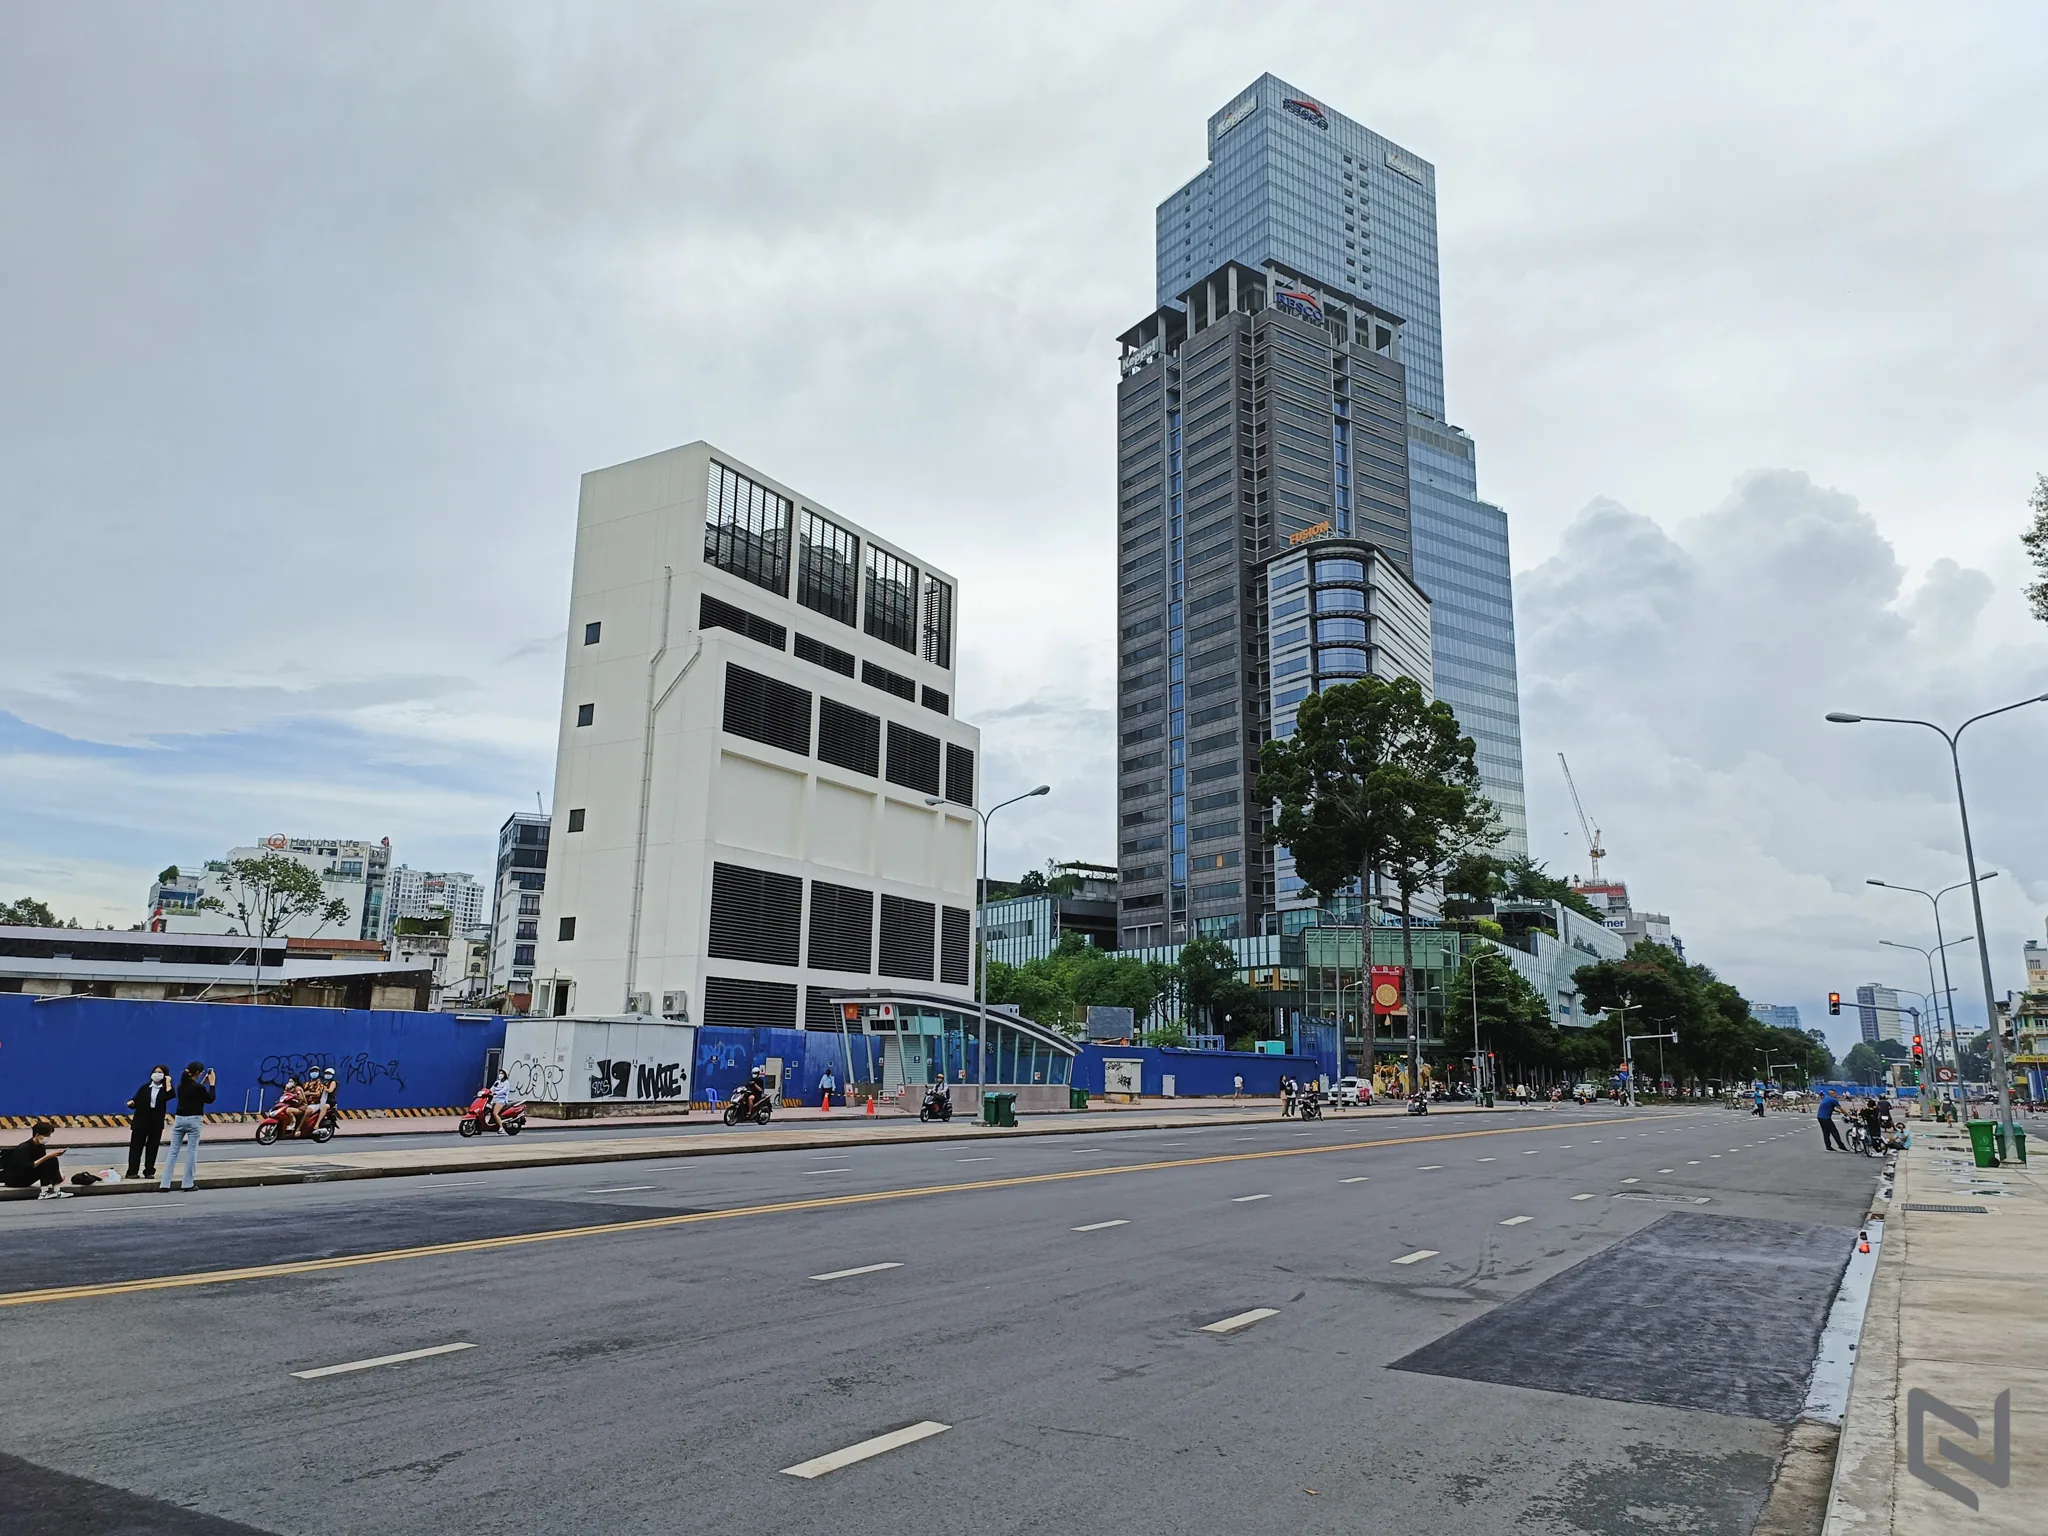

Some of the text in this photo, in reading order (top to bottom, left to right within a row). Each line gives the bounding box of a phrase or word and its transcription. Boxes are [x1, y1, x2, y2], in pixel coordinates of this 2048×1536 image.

[1276, 293, 1324, 321] RESCO
[1122, 340, 1156, 371] Keppel
[1290, 520, 1330, 545] FUSION
[291, 838, 360, 847] Hanwha Life
